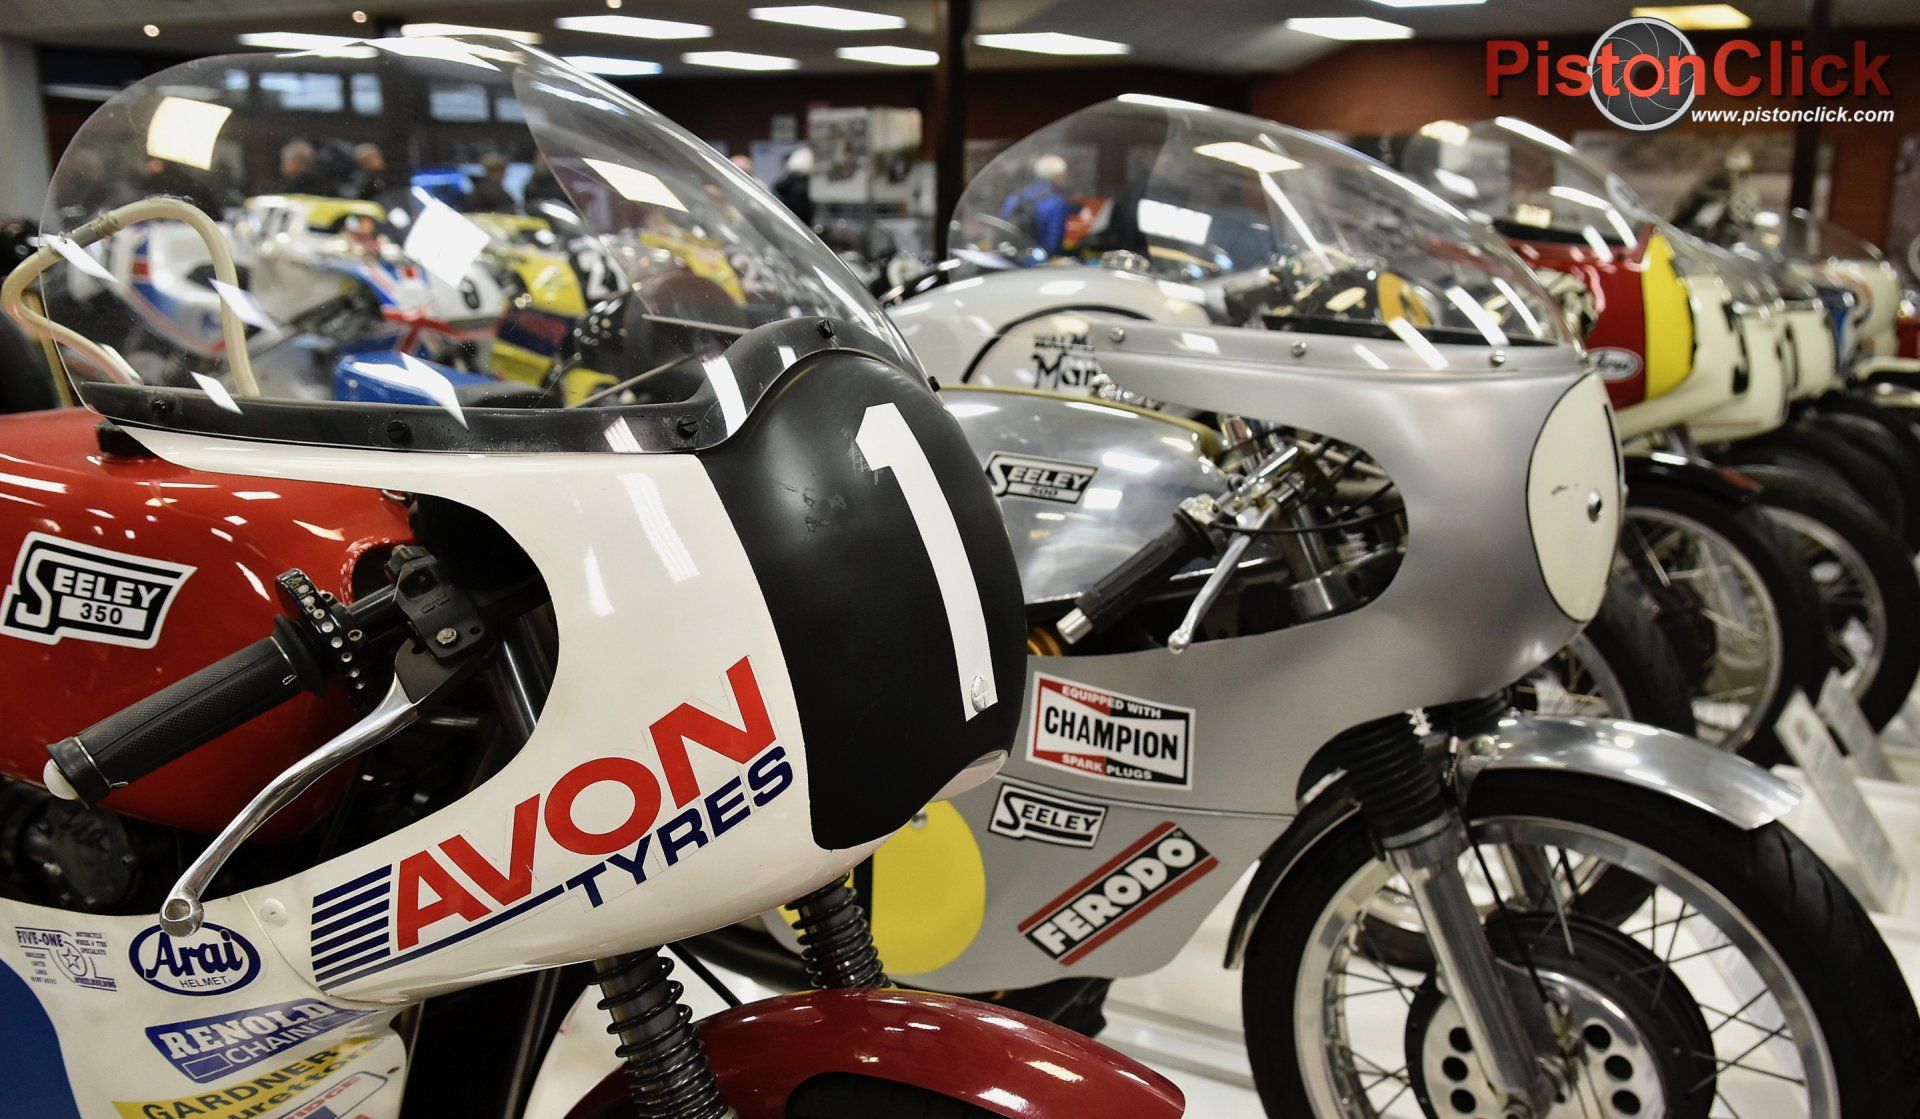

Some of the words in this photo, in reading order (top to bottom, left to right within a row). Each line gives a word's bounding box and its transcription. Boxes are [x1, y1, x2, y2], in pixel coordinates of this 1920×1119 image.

[987, 455, 1096, 496] SEELEY
[854, 402, 998, 721] 1
[15, 548, 172, 628] SEELEY
[80, 602, 123, 625] 350
[1061, 685, 1125, 710] EQUIPPED
[1126, 701, 1162, 719] WITH
[1044, 706, 1178, 760] CHAMPION
[1061, 753, 1104, 773] SPARK
[1106, 765, 1153, 781] PLUGS
[398, 655, 777, 951] AVON
[566, 745, 794, 908] TYRES
[996, 790, 1101, 836] SEELEY
[1031, 837, 1196, 956] FERODO
[15, 931, 64, 948] FIVE-ONE
[146, 929, 243, 979] Arai
[179, 976, 228, 988] HELMET
[158, 1003, 336, 1060] RENOLD
[225, 1022, 320, 1065] CHAIN
[141, 1050, 339, 1119] GARDNER
